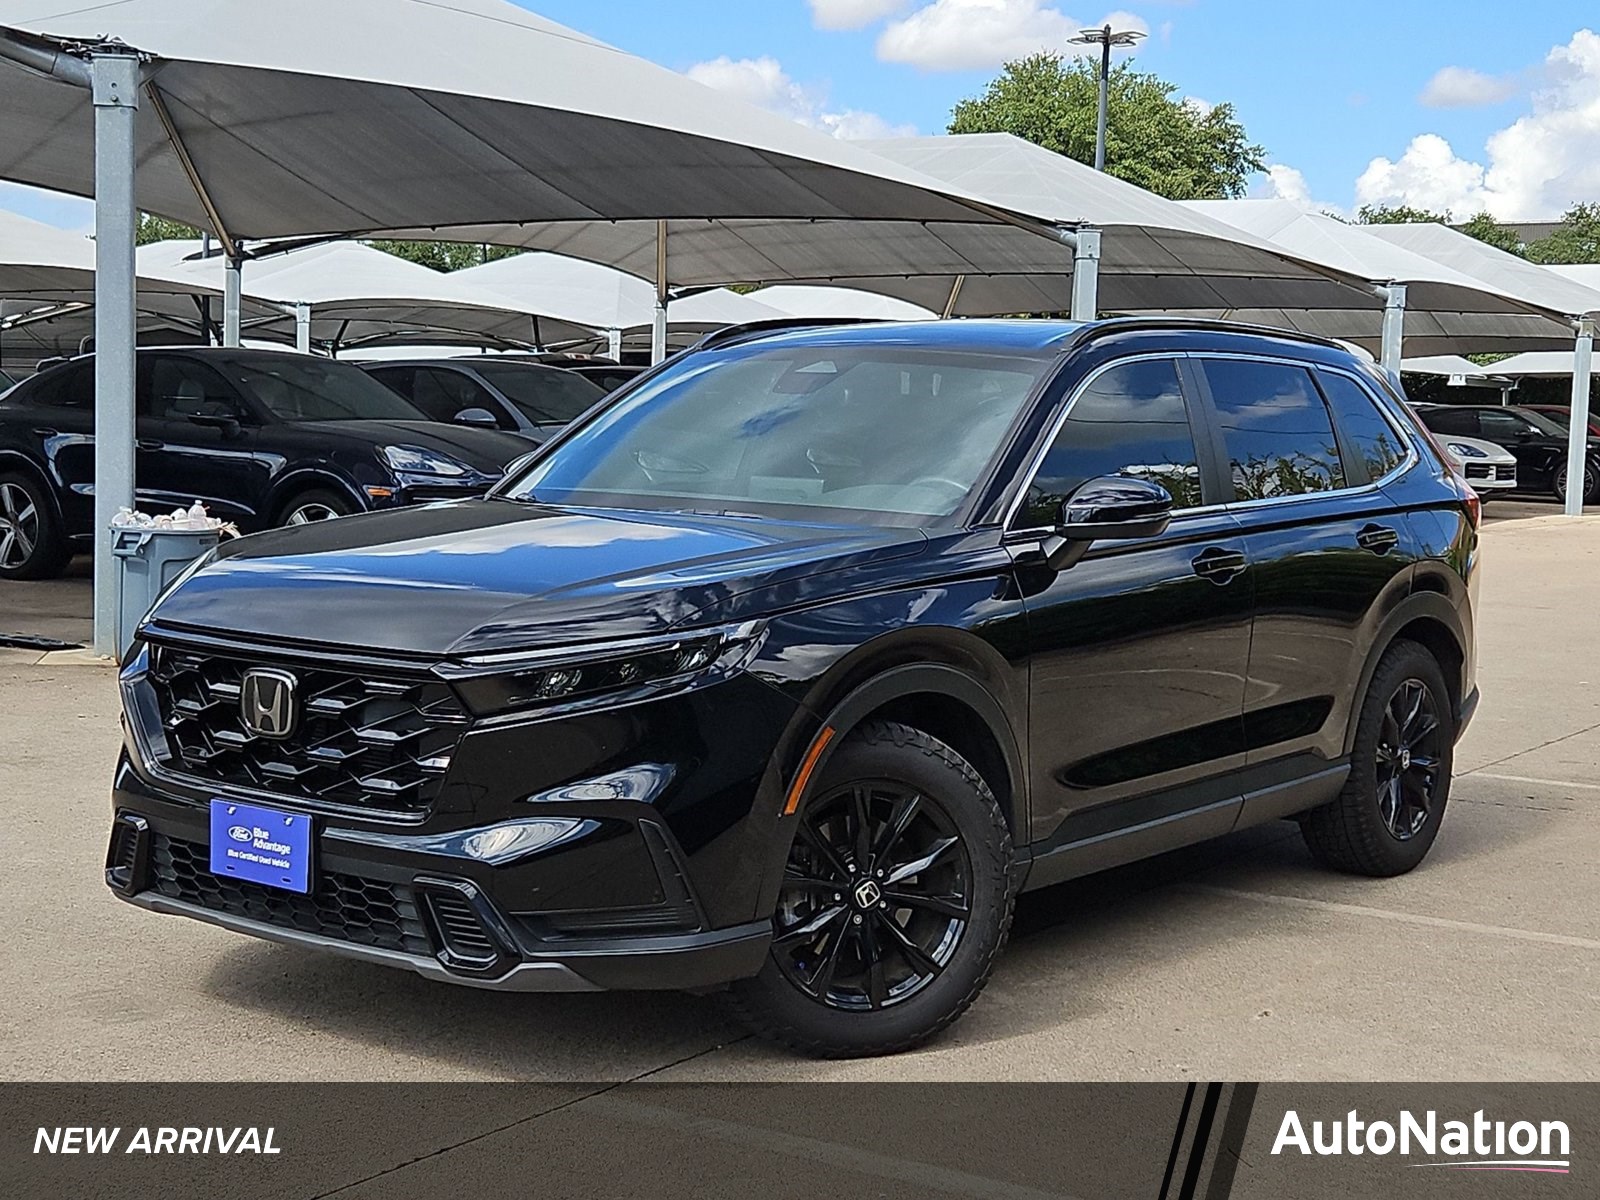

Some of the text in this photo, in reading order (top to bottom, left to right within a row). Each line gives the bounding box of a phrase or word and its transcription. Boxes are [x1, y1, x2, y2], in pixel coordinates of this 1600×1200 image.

[253, 827, 270, 840] Blue
[252, 839, 291, 855] Advantage
[239, 851, 259, 862] Certified
[272, 858, 290, 869] Vehicle
